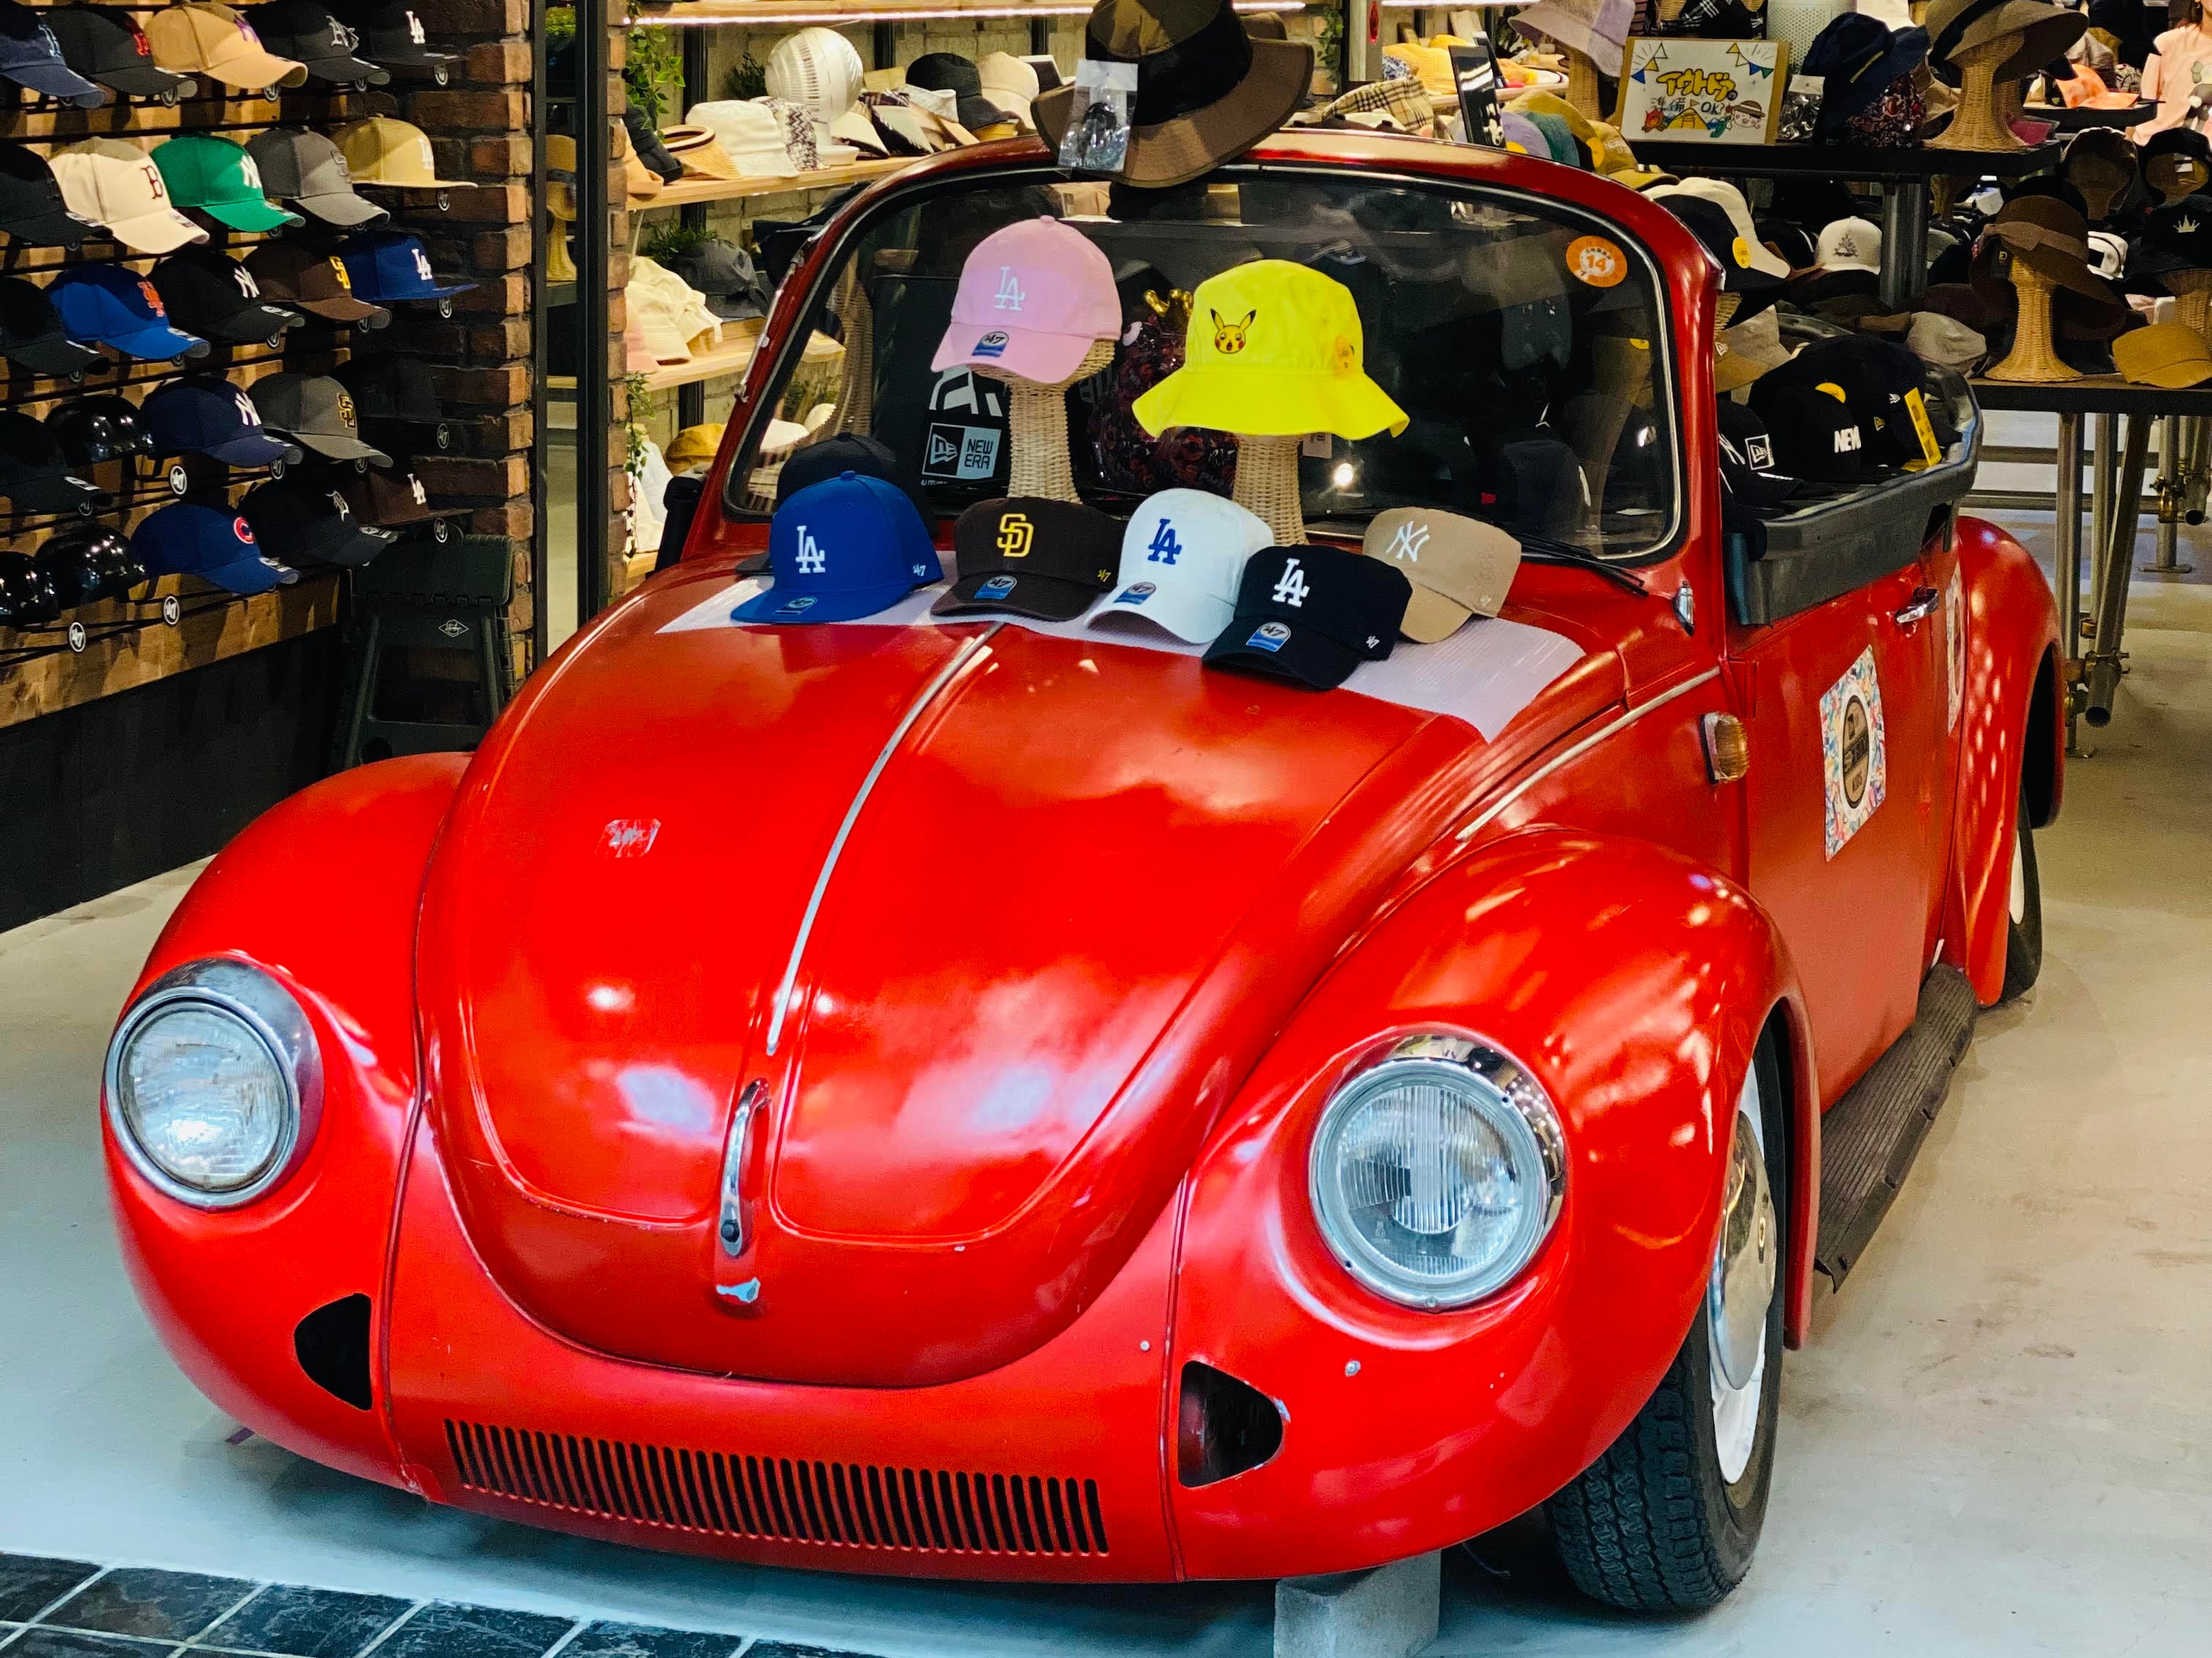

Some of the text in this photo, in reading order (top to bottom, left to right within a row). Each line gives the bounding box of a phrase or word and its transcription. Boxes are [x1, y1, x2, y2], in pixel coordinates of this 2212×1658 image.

[405, 11, 425, 44] LA
[140, 165, 163, 200] B
[411, 249, 432, 281] LA
[995, 266, 1026, 312] LA
[964, 453, 990, 470] ERA
[967, 439, 993, 453] NEW
[407, 473, 426, 505] LA
[233, 516, 255, 544] C
[996, 513, 1034, 557] SD
[1147, 518, 1182, 565] LA
[1385, 520, 1430, 562] NY
[796, 525, 826, 573] LA
[1271, 557, 1310, 608] LA
